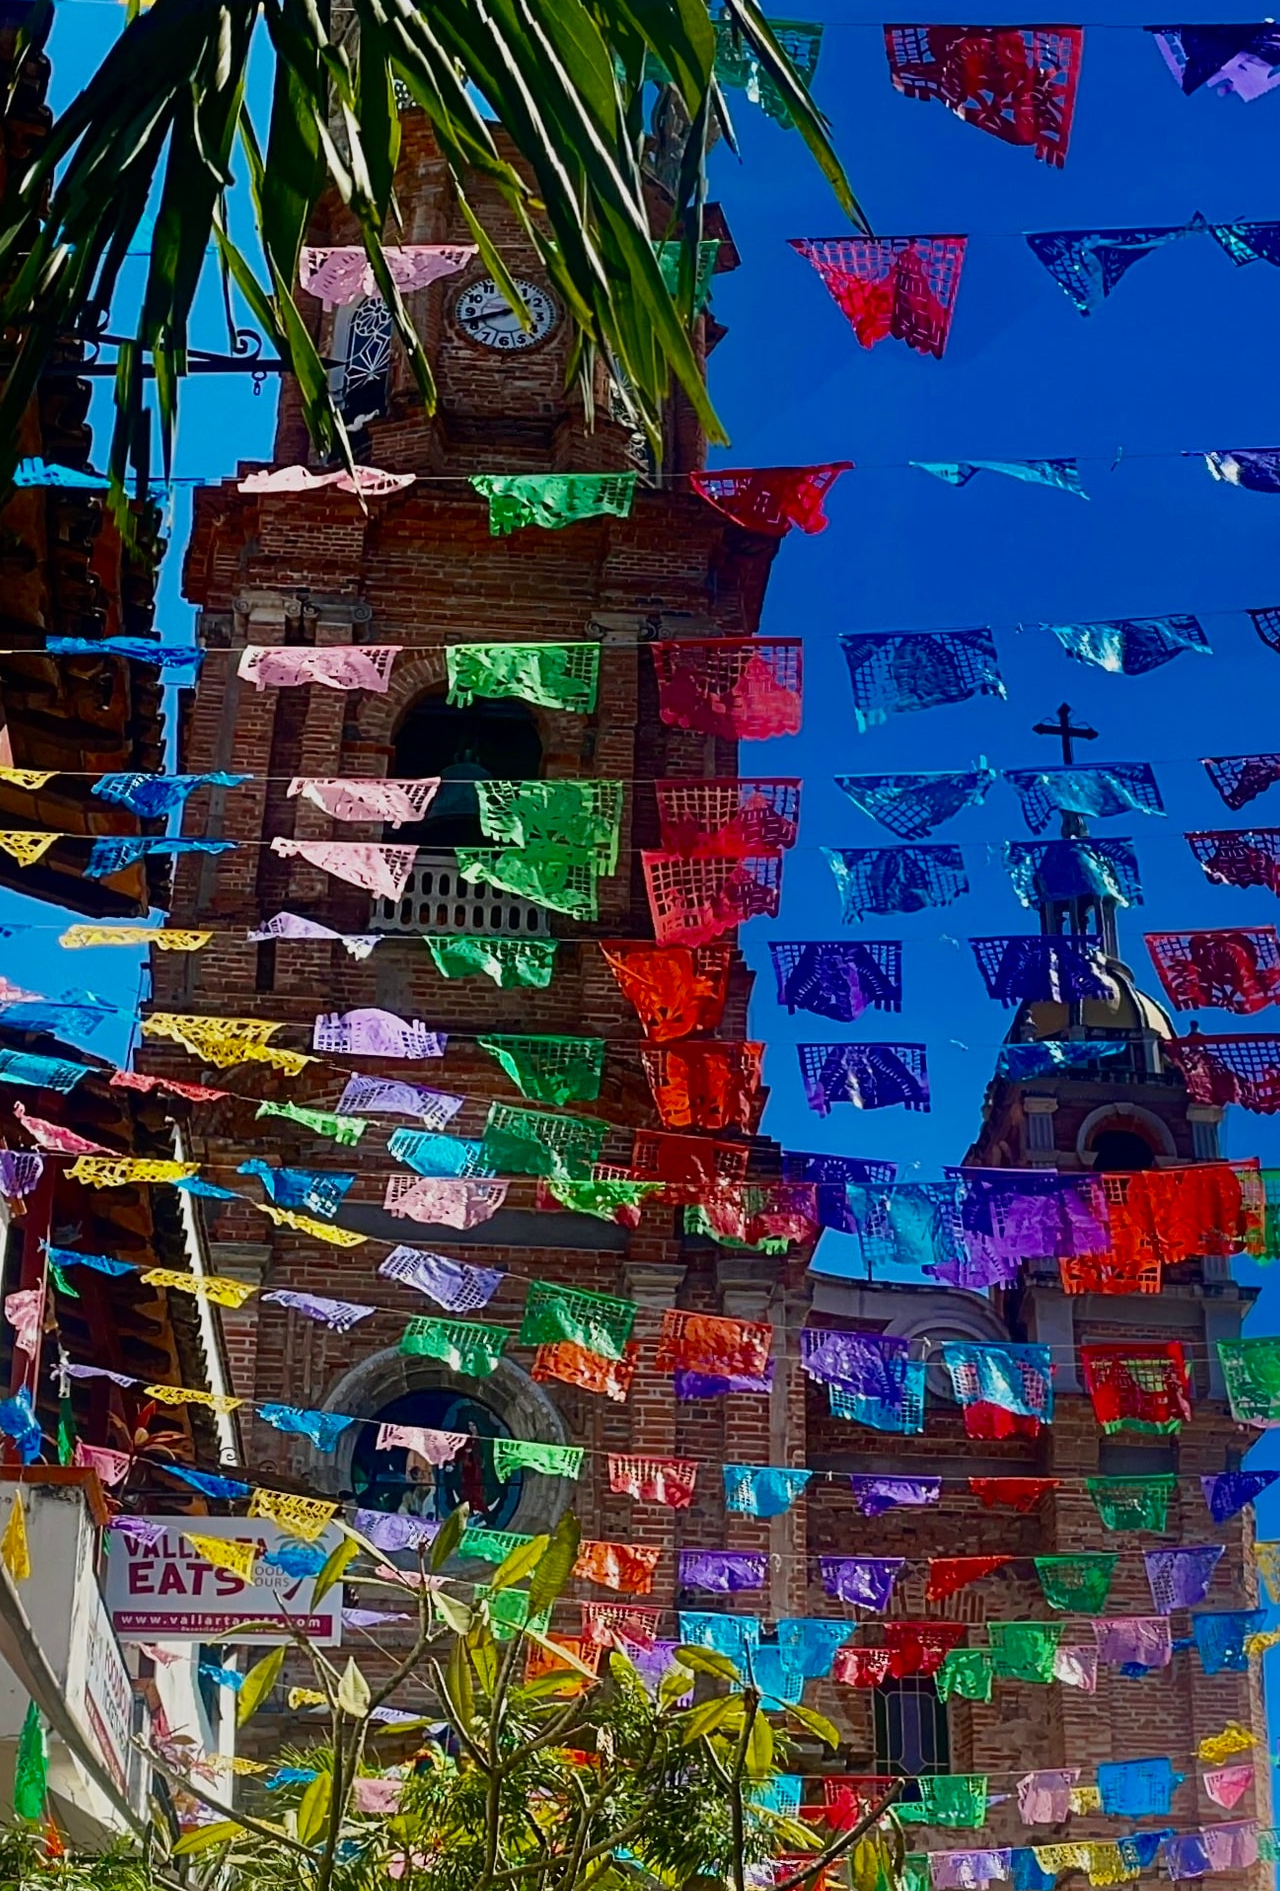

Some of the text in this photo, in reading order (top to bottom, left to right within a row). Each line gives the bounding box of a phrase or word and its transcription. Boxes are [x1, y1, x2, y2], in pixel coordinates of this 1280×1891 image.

[254, 1565, 285, 1576] OOD
[129, 1561, 246, 1596] EATS
[254, 1577, 290, 1588] OURS
